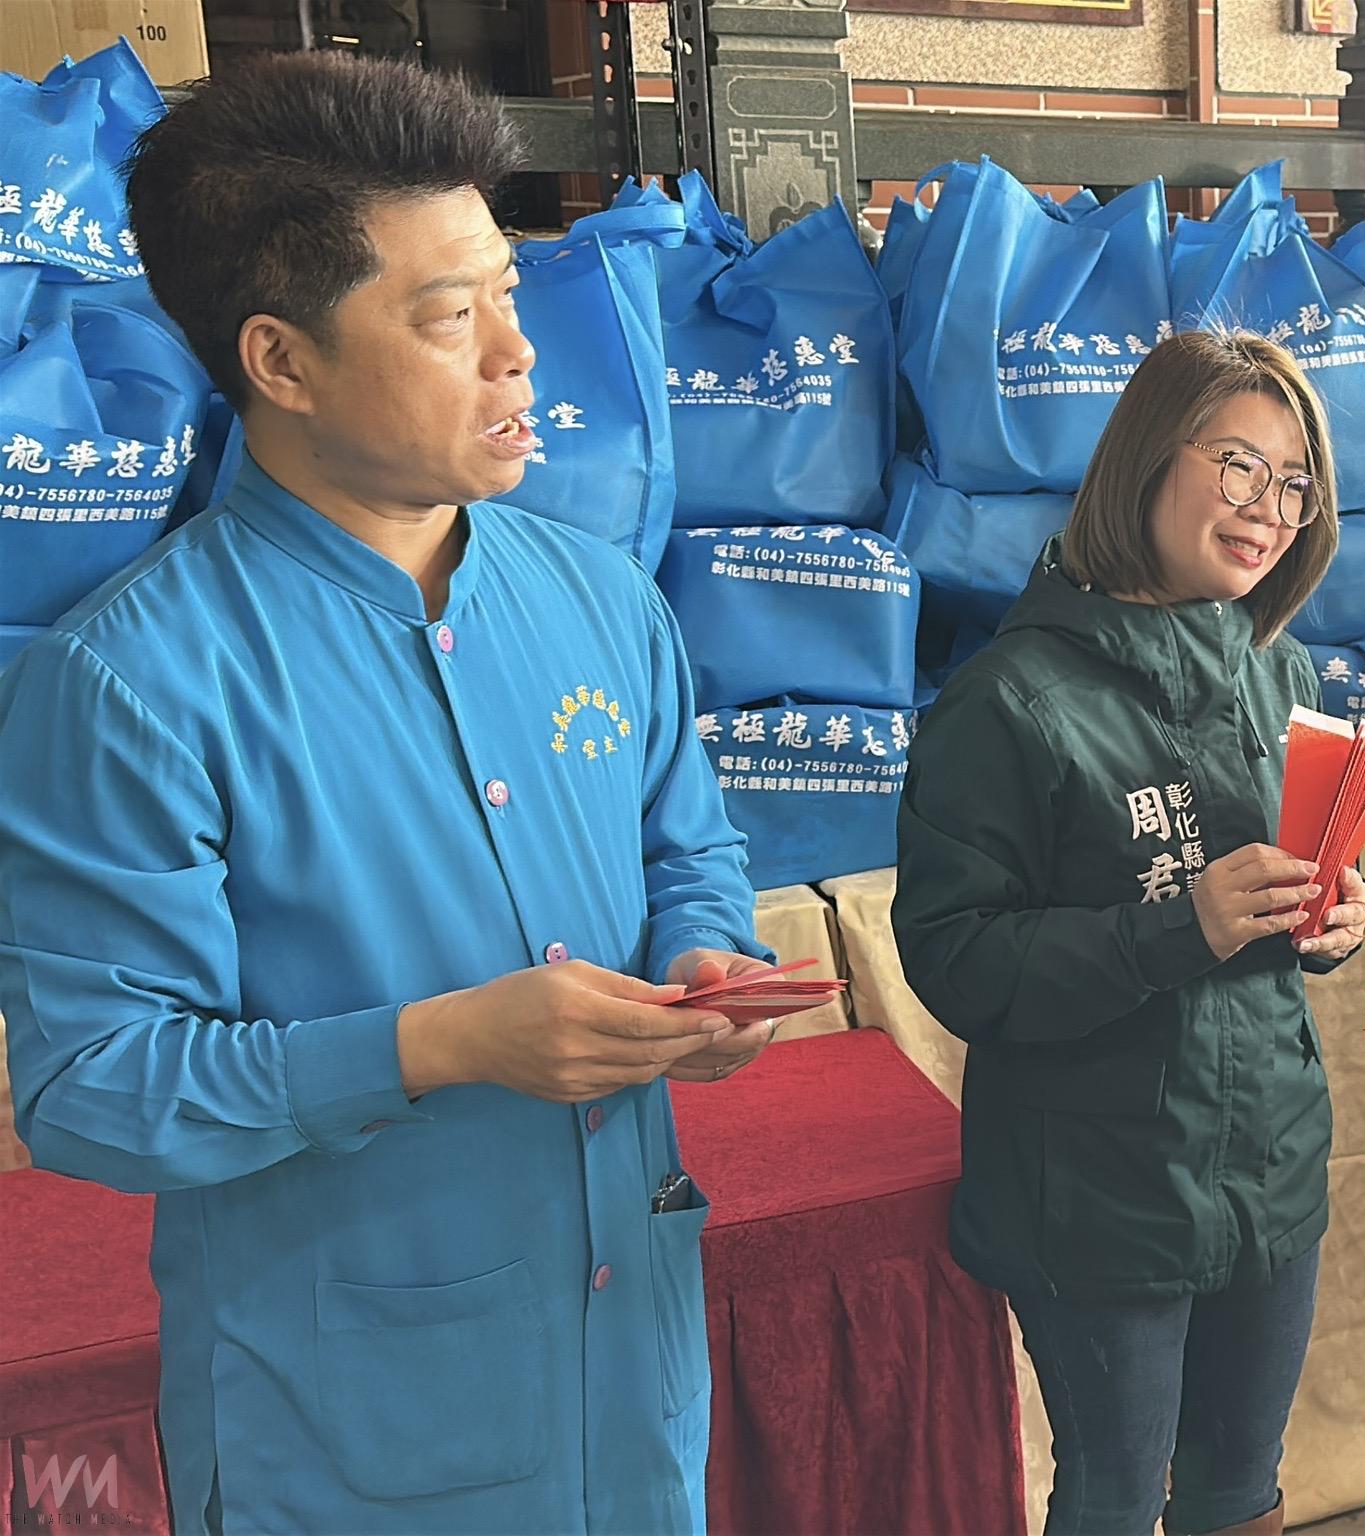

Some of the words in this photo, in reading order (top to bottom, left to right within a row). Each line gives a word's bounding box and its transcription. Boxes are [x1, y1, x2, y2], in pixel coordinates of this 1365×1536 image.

[136, 25, 166, 41] 100
[0, 504, 168, 522] 美鎮四張里西美路115號
